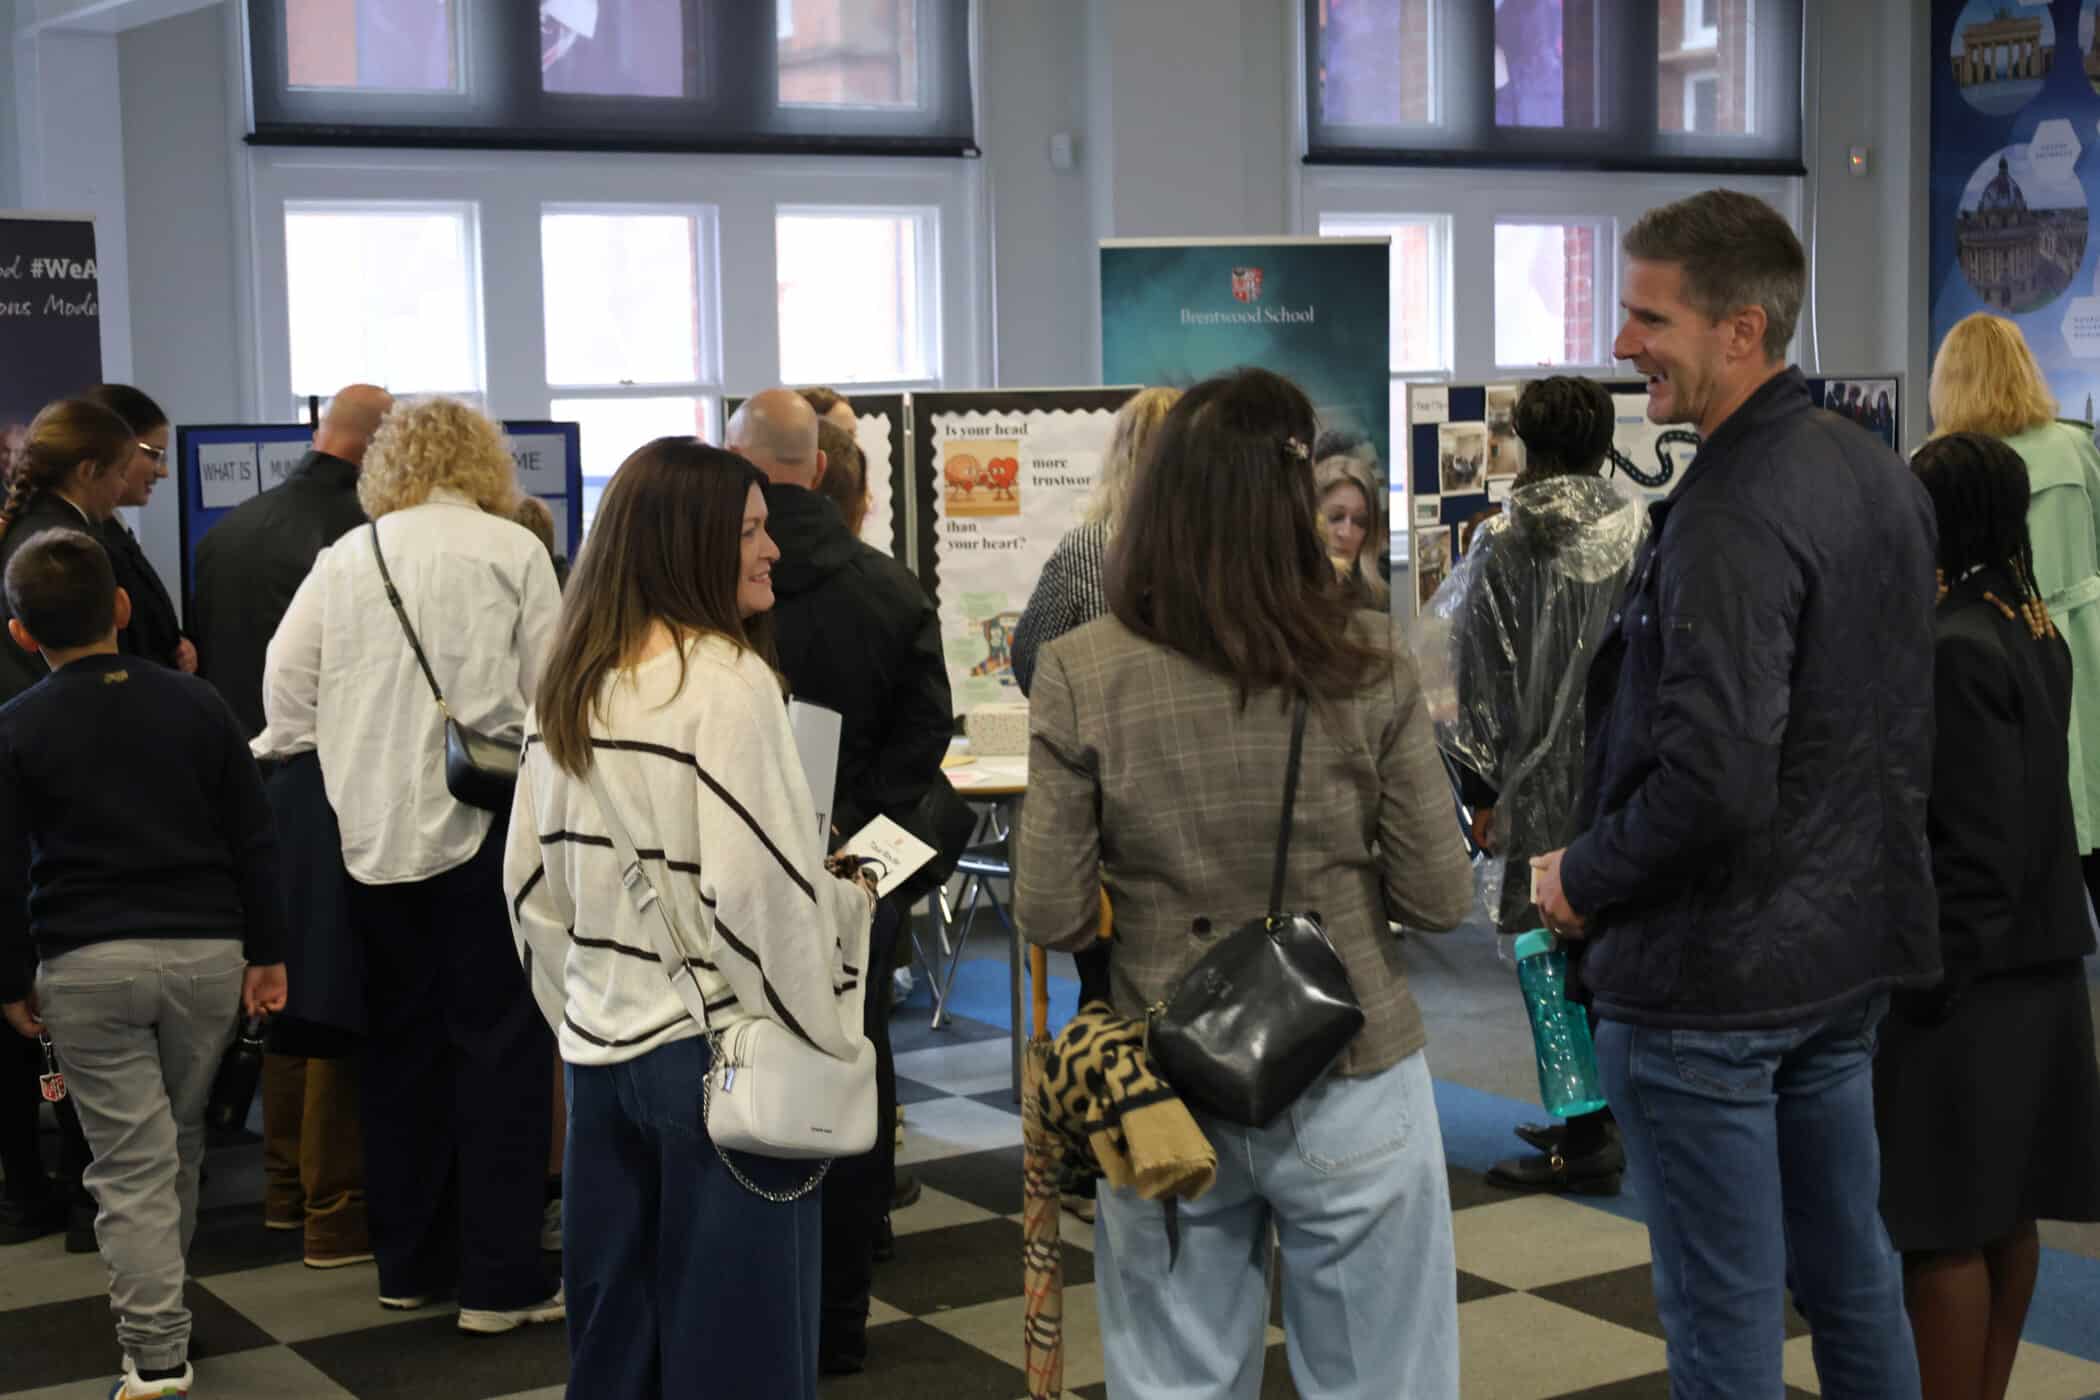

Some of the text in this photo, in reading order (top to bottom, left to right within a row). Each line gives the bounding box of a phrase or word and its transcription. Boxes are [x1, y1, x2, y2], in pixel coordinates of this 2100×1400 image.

[30, 258, 96, 279] #WeA
[1180, 306, 1314, 325] Brentwood School
[960, 426, 991, 438] your
[995, 423, 1028, 436] head
[203, 461, 251, 481] WHAT IS
[1032, 459, 1068, 469] more
[946, 520, 977, 533] than
[948, 541, 979, 552] your
